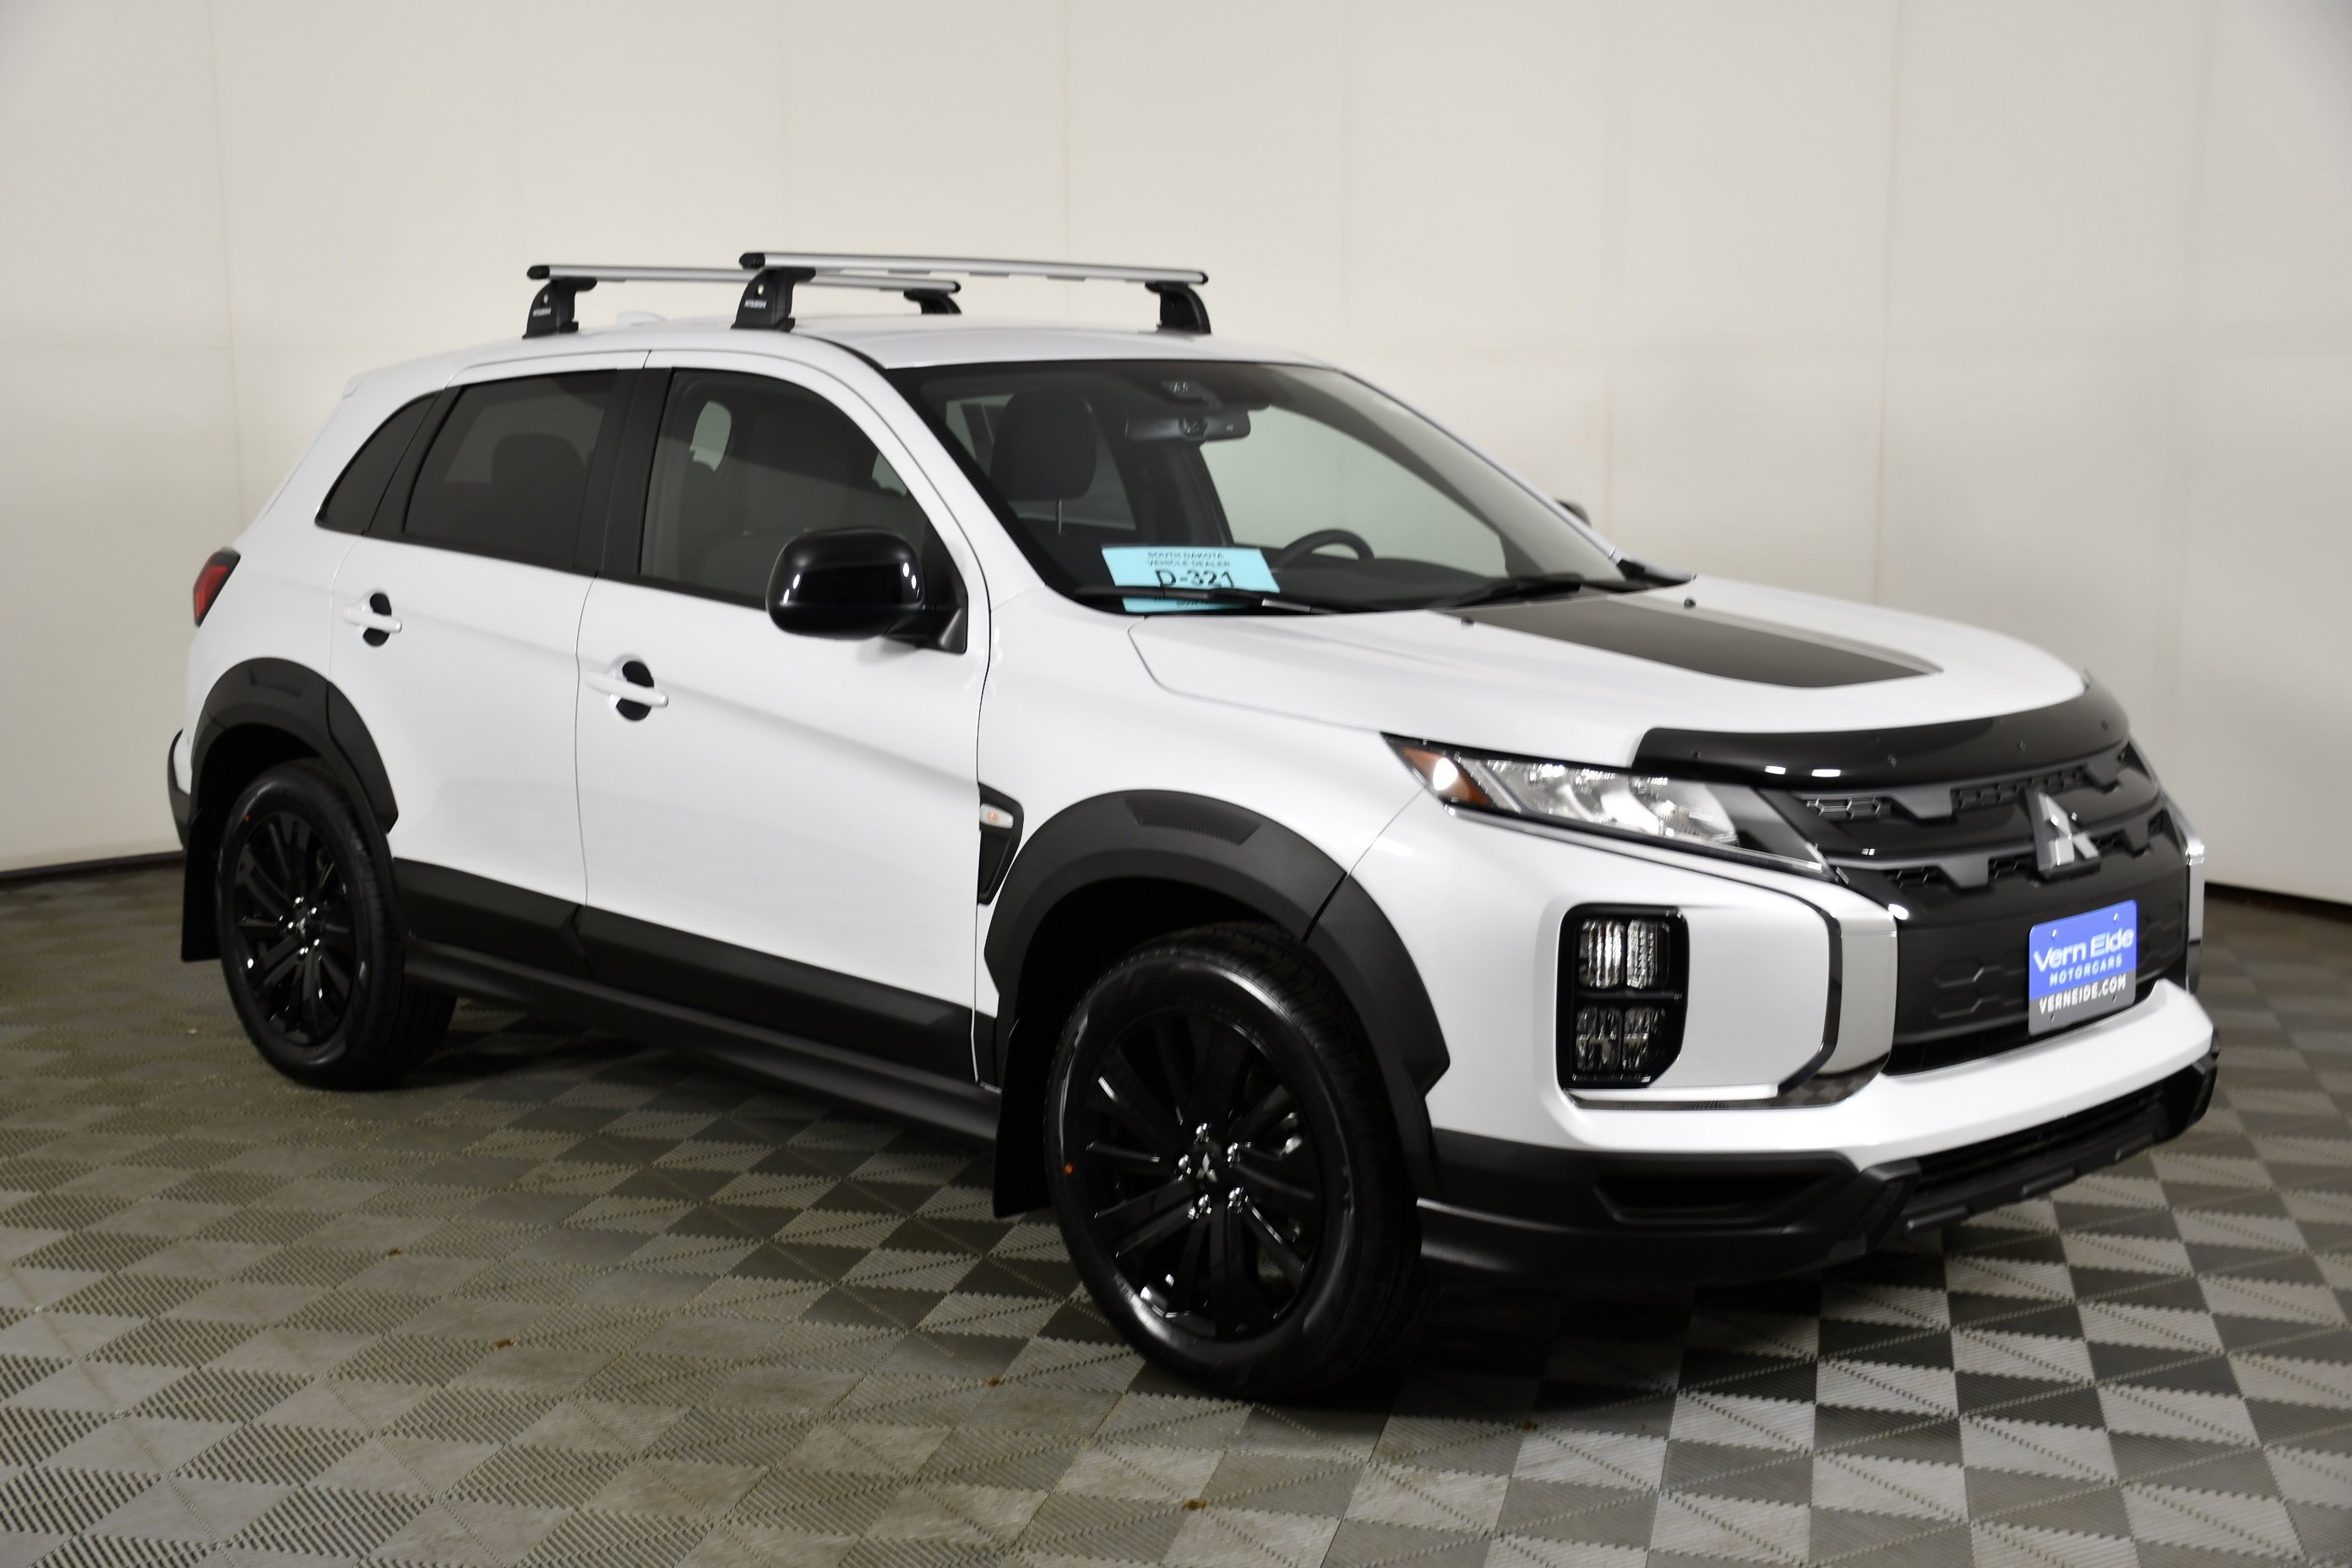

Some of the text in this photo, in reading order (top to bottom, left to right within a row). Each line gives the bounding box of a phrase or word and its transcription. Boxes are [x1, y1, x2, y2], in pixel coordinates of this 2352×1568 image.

[1155, 569, 1235, 589] D-321
[2033, 928, 2134, 972] Vern Eide
[2050, 953, 2123, 988] MOTORCARS
[2039, 972, 2126, 1015] VERNEIDE.COM
